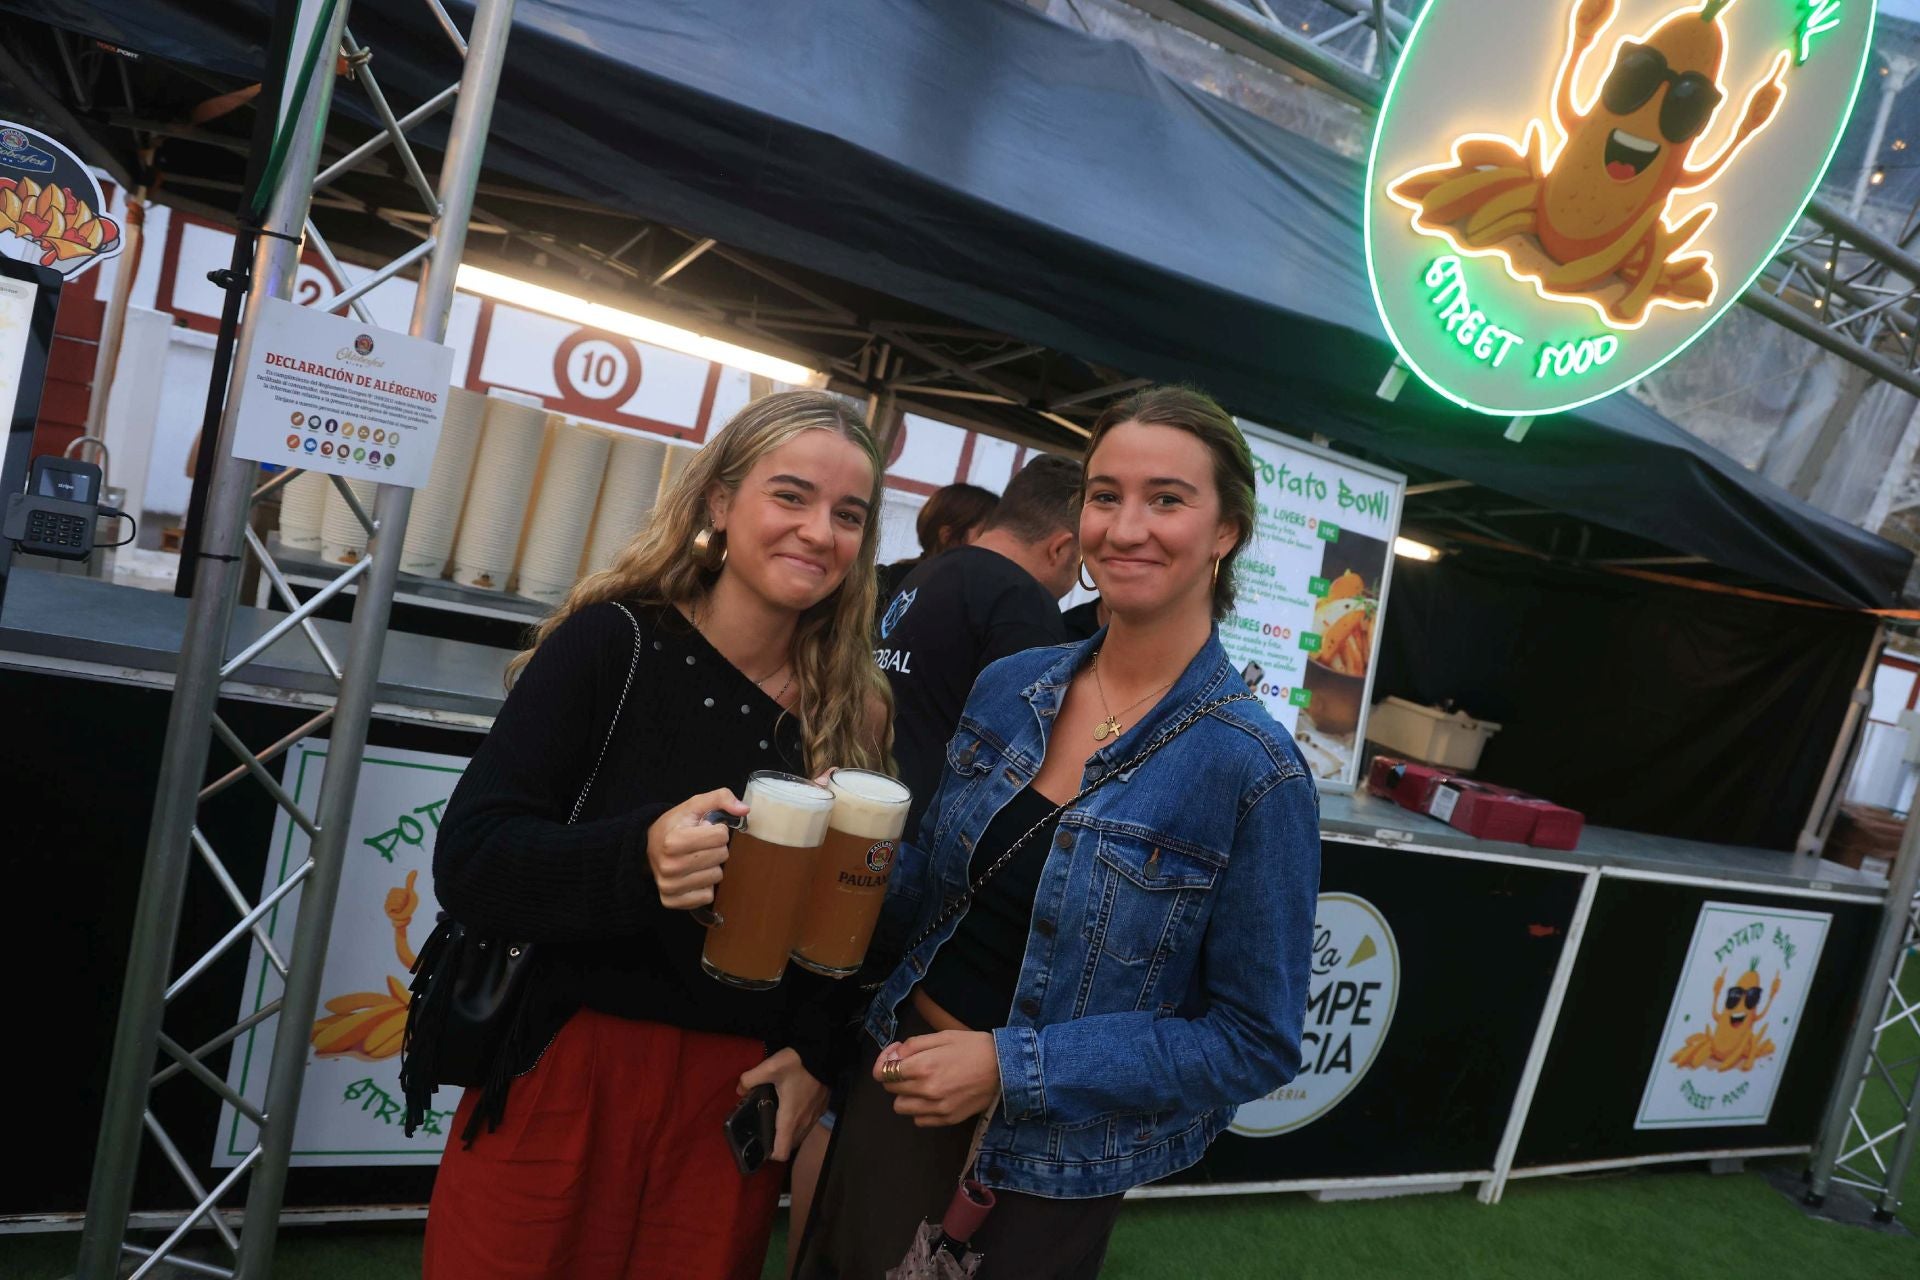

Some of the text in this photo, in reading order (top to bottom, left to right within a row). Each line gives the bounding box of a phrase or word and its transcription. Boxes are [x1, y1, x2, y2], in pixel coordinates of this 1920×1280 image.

[1800, 0, 1841, 61] WL
[298, 279, 321, 307] 2
[1425, 255, 1618, 378] STREET FOOD
[265, 352, 438, 404] DECLARACIÓN DE ALÉRGENOS
[582, 350, 616, 387] 10
[1252, 454, 1327, 502] Potato
[1274, 507, 1306, 527] LOVERS
[872, 649, 911, 674] OBAL
[363, 799, 447, 863] POT
[837, 871, 889, 888] PAULAN
[1714, 922, 1765, 962] POTATO
[1307, 981, 1382, 1026] MPE
[1298, 1031, 1352, 1075] CIA
[342, 1078, 457, 1136] STRE
